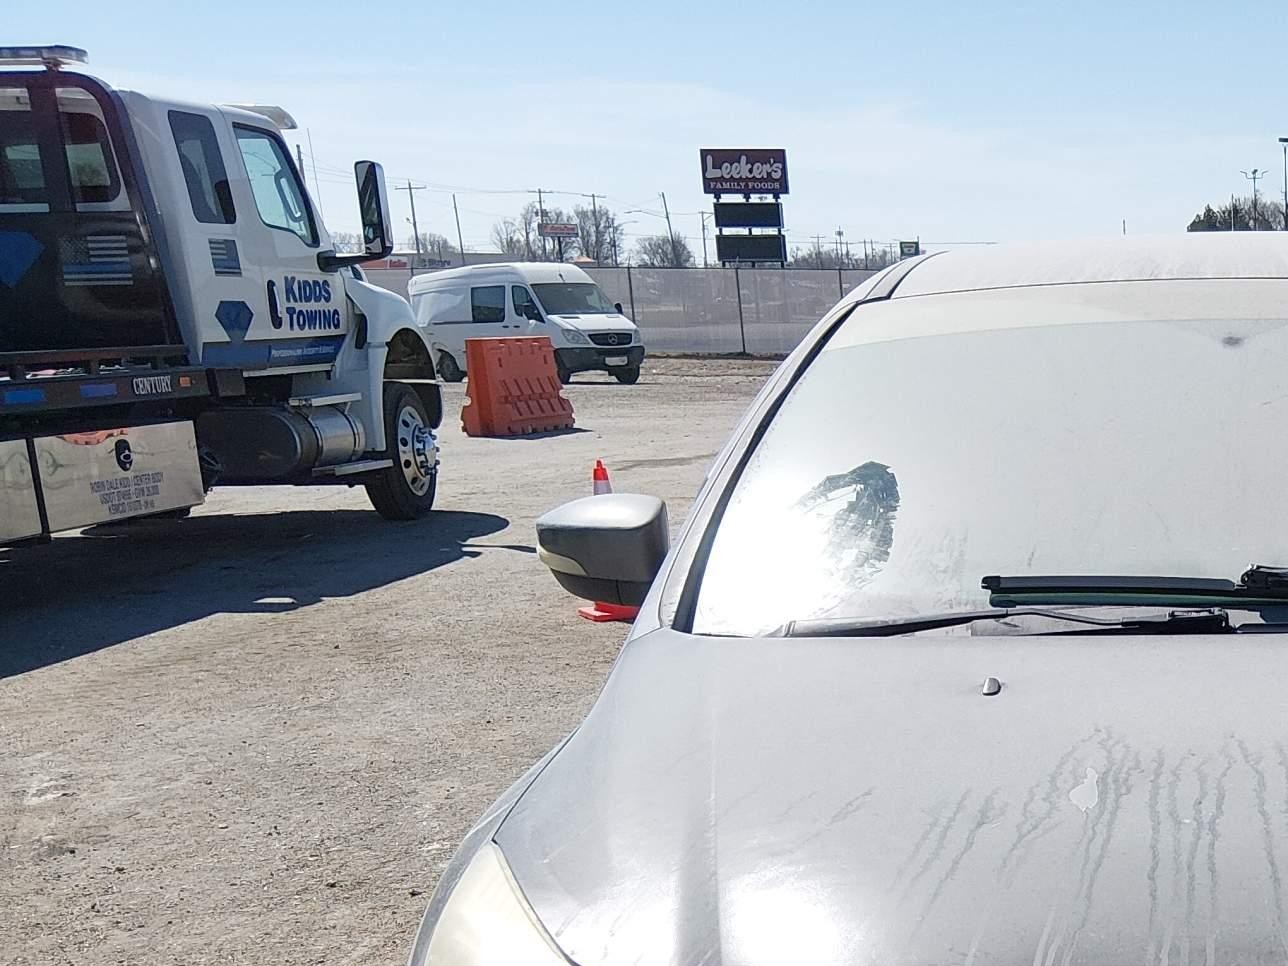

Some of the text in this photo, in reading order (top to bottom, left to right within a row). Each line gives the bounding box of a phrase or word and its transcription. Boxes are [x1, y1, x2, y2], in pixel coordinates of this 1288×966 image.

[705, 155, 782, 179] Leeker's
[284, 276, 331, 303] KIDDS
[286, 306, 340, 331] TOWING
[133, 376, 172, 394] CENTURY
